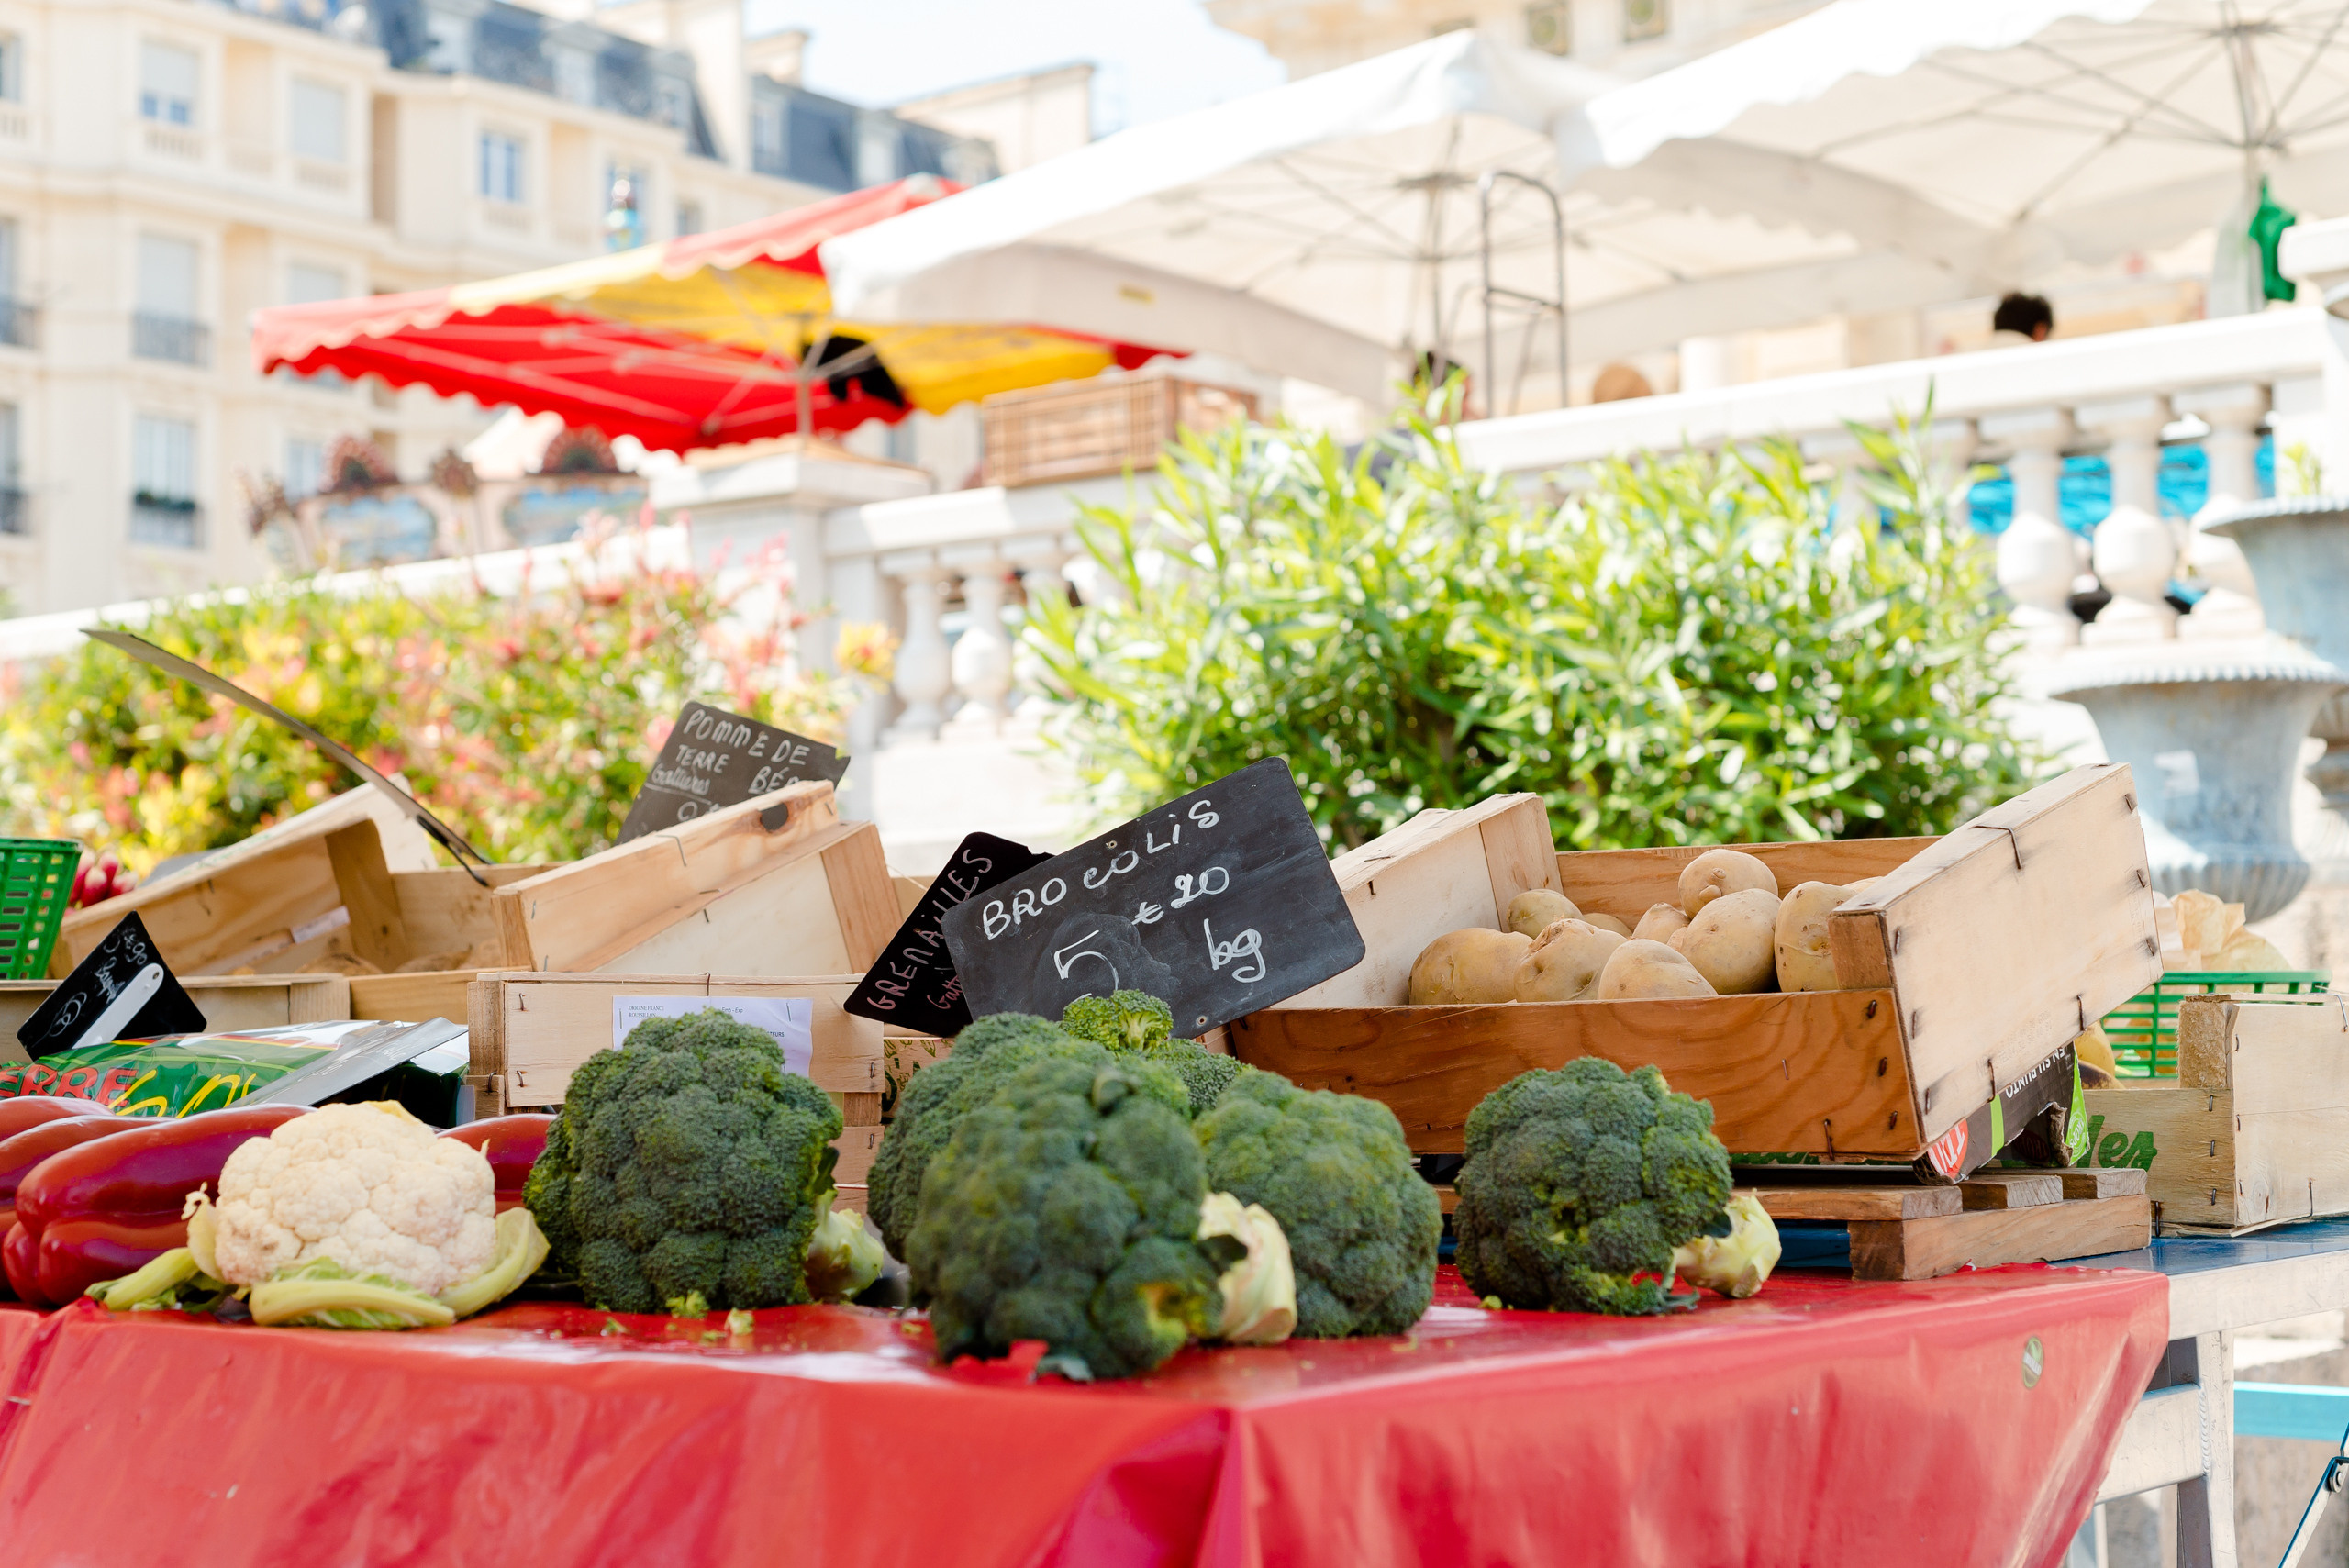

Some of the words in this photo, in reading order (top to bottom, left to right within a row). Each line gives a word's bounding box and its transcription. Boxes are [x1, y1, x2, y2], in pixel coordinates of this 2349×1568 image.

[675, 744, 730, 773] TERRE
[683, 709, 769, 758] POMME
[771, 739, 810, 766] DE
